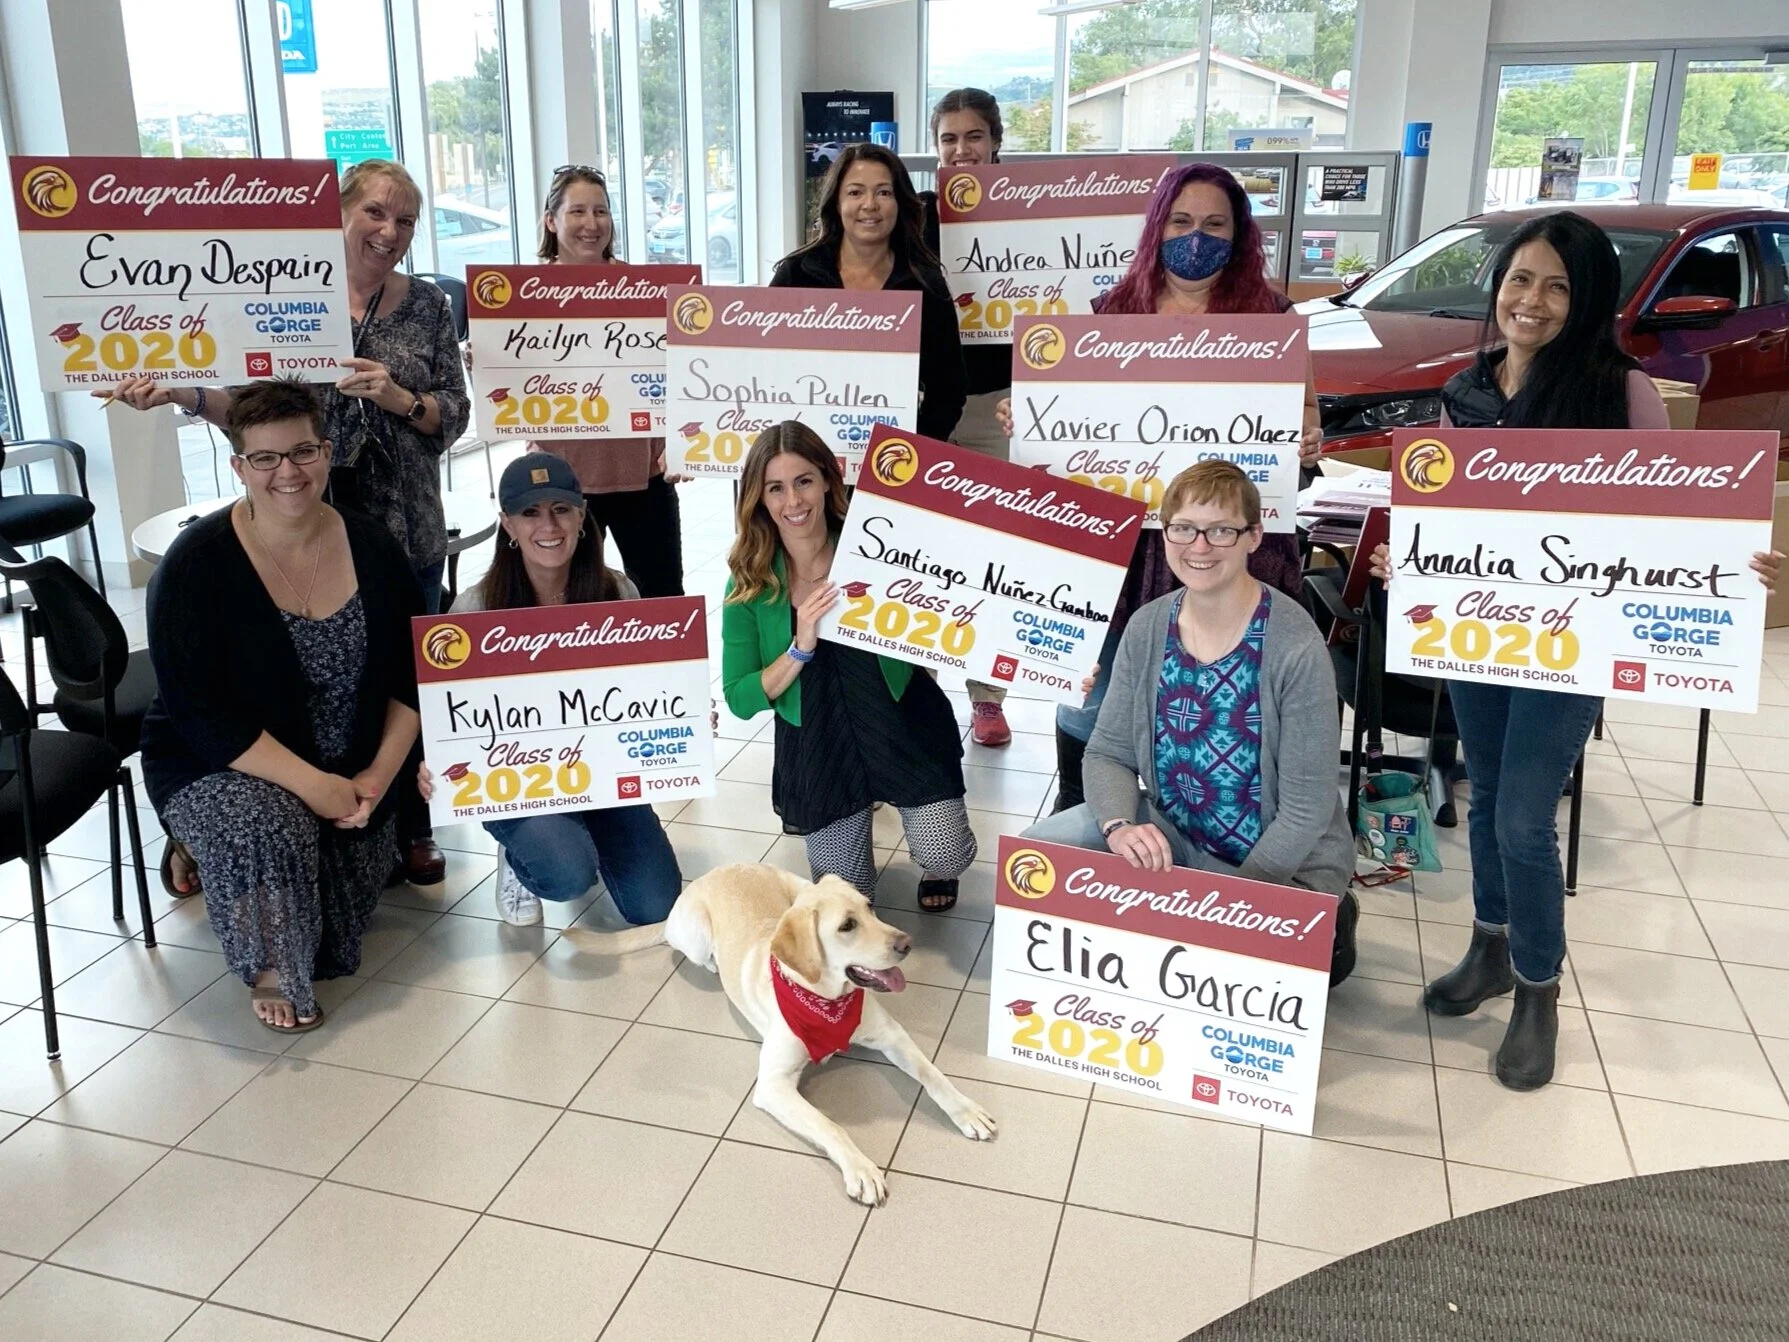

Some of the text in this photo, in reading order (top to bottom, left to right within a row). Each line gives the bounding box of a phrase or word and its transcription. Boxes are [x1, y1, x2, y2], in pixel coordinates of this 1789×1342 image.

[340, 133, 356, 141] City
[88, 173, 330, 217] Congratulations!
[989, 166, 1171, 208] Congratulations!
[80, 233, 333, 302] Evan Despain
[956, 233, 1136, 273] Andrea Nuñe
[520, 274, 696, 308] Congratulation
[988, 275, 1066, 304] Class of
[100, 303, 209, 339] Class of
[244, 302, 329, 316] COLUMBIA
[256, 316, 322, 334] GORGE
[720, 300, 915, 337] Congratulations!
[270, 335, 311, 343] TOYOTA
[504, 322, 592, 362] Kailyn
[978, 330, 1009, 338] DALLES
[1074, 329, 1300, 369] Congratulations!
[64, 331, 217, 372] 2020
[278, 358, 337, 369] TOYOTA
[65, 374, 89, 383] THE
[91, 373, 137, 383] DALLES
[171, 370, 220, 380] SCHOOL
[523, 373, 605, 401] Class of
[631, 373, 666, 384] COLU
[683, 358, 889, 412] Sophia Pullen
[494, 395, 609, 425] 2020
[717, 409, 773, 432] Class
[1023, 395, 1300, 445] Xavier Orion Olaez
[515, 426, 549, 434] DALLES
[551, 426, 573, 434] HIGH
[574, 425, 611, 433] SCHOOL
[837, 427, 871, 441] GOR
[685, 431, 760, 464] 20
[704, 465, 739, 473] DALLES
[1066, 450, 1164, 483] Class of
[1465, 447, 1766, 496] Congratulations!
[924, 460, 1137, 540] Congratulations!
[858, 516, 967, 590] Santiago
[1398, 522, 1740, 598] Annalia Singhurst
[886, 579, 985, 628] Class of
[1455, 591, 1579, 636] Class of
[1622, 602, 1734, 626] COLUMBIA
[480, 608, 699, 661] Congratulations!
[839, 594, 976, 657] 2020
[1012, 610, 1085, 641] COLUMBIA
[1016, 628, 1075, 655] GORGE
[1633, 622, 1721, 646] GORGE
[836, 626, 967, 670] THE DALLES HIGH SCHOOL
[1024, 645, 1060, 662] TOYOTA
[1410, 616, 1580, 671] 2020
[1649, 644, 1703, 658] TOYOTA
[1022, 668, 1073, 691] TOYOTA
[1411, 658, 1579, 685] THE DALLES HIGH SCHOOL
[1654, 672, 1734, 694] TOYOTA
[447, 687, 687, 751] Kylan McCavic
[618, 726, 694, 744] COLUMBIA
[487, 735, 586, 769] Class of
[627, 742, 687, 758] GORGE
[640, 757, 677, 767] TOYOTA
[453, 760, 592, 808] 2020
[646, 776, 701, 791] TOYOTA
[453, 795, 593, 818] THE DALLES HIGH SCHOOL
[1064, 867, 1326, 940] Congratulations!
[1027, 919, 1309, 1031] Elia Garcia
[1053, 994, 1165, 1046] Class of
[1011, 1013, 1164, 1077] 2020
[1201, 1024, 1295, 1058] COLUMBIA
[1011, 1046, 1163, 1091] THE DALLES HIGH SCHOOL
[1210, 1045, 1284, 1073] GORGE
[1224, 1063, 1270, 1082] TOYOTA
[1227, 1089, 1294, 1116] TOYOTA
